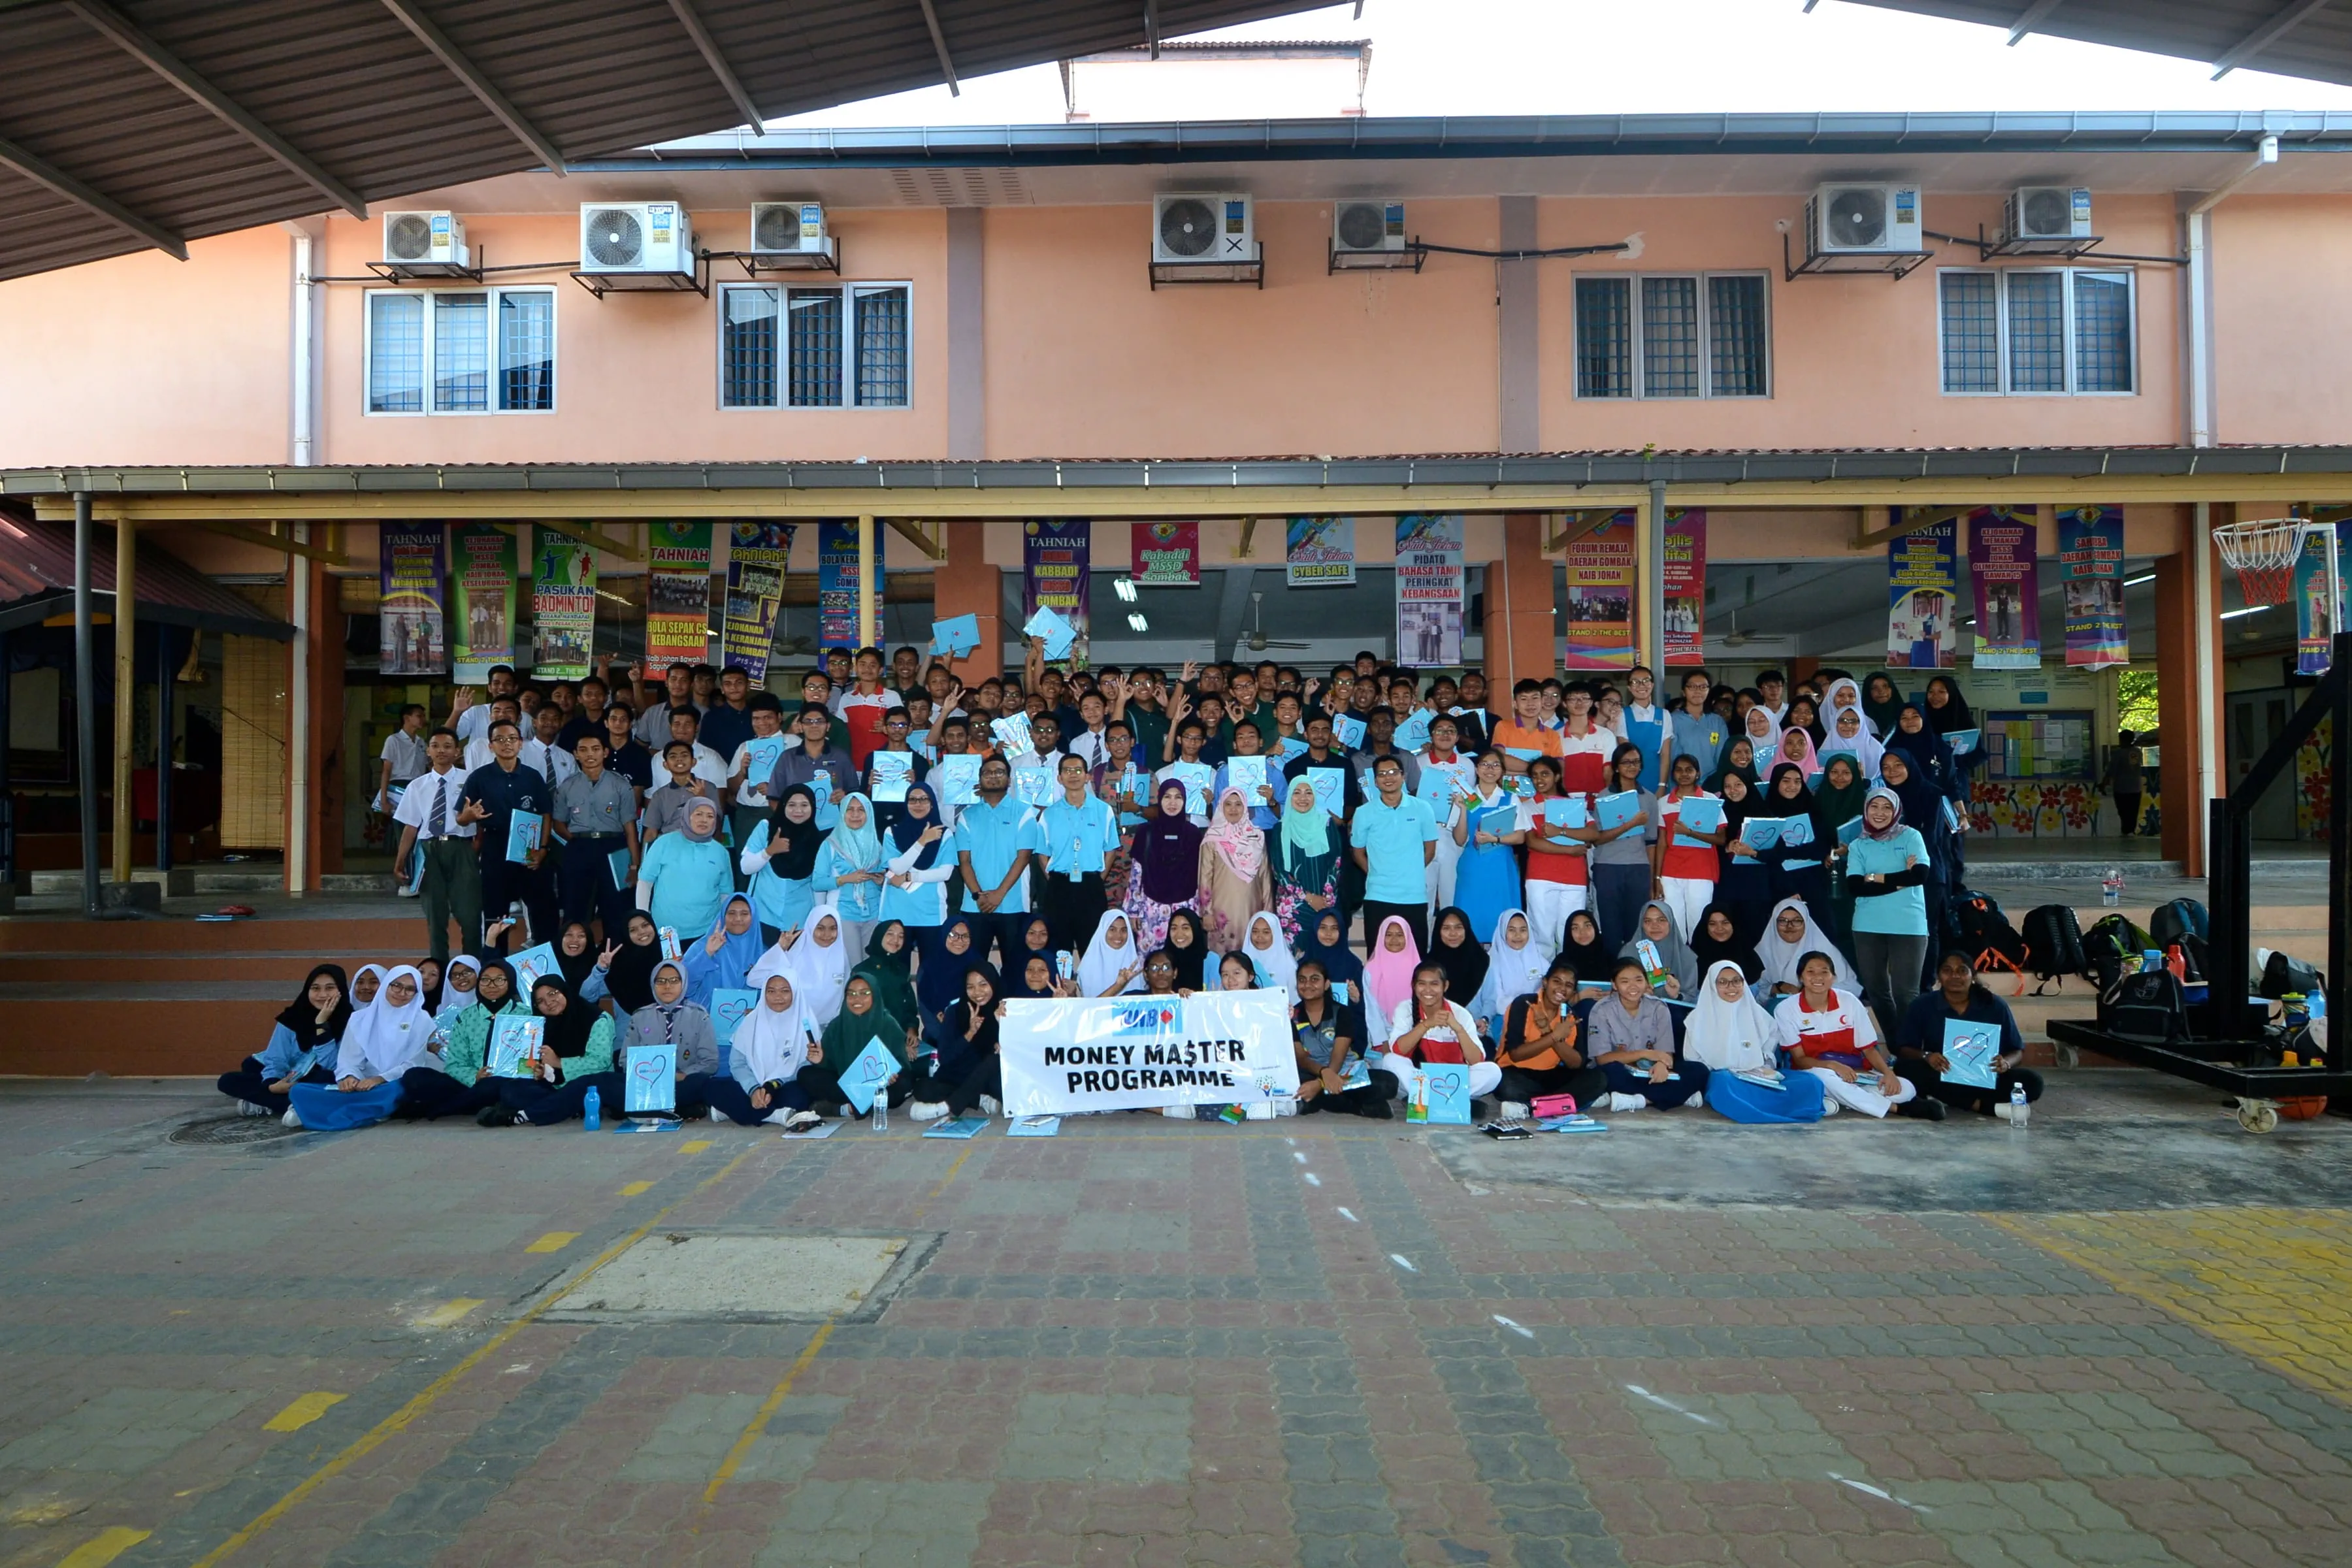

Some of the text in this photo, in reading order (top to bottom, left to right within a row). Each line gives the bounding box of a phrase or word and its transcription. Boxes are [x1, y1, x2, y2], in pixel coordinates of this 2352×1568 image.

[1911, 527, 1951, 536] HNIAH
[385, 534, 442, 544] TAHNIAH
[1028, 537, 1086, 547] TAHNIAH
[1665, 534, 1693, 547] ajlis
[1426, 536, 1462, 553] Johan
[1573, 544, 1628, 553] FORUM REMAJA
[651, 547, 708, 561] TAHNIAH
[1141, 549, 1189, 561] Kabaddi
[2061, 551, 2092, 562] DAERAH
[821, 555, 840, 564] BOLA
[1414, 555, 1445, 564] PIDATO
[1569, 557, 1631, 566] DAERAH GOMBAK
[1150, 561, 1182, 571] MSSD
[1294, 564, 1348, 577] CYBER SAFE
[1399, 566, 1433, 576] BAHASA
[2073, 564, 2093, 574] NAIB
[1034, 566, 1078, 578] KABBADI
[1142, 572, 1189, 581] Gombak
[1578, 570, 1621, 580] NAIB JOHAN
[835, 578, 860, 588] GOMB
[1406, 578, 1454, 587] PERINGKAT
[537, 585, 594, 596] PASUKAN
[1403, 589, 1460, 598] KEBANGSAAN
[1037, 595, 1079, 607] GOMBAK
[648, 621, 666, 633] BOLA
[668, 621, 694, 634] SEPAK
[2066, 624, 2093, 632] STAND
[651, 634, 705, 647] KEBANGSAAN
[736, 645, 768, 658] GOMBAK
[1045, 1040, 1245, 1068] MONEY MA$TER
[1067, 1070, 1235, 1093] PROGRAMME
